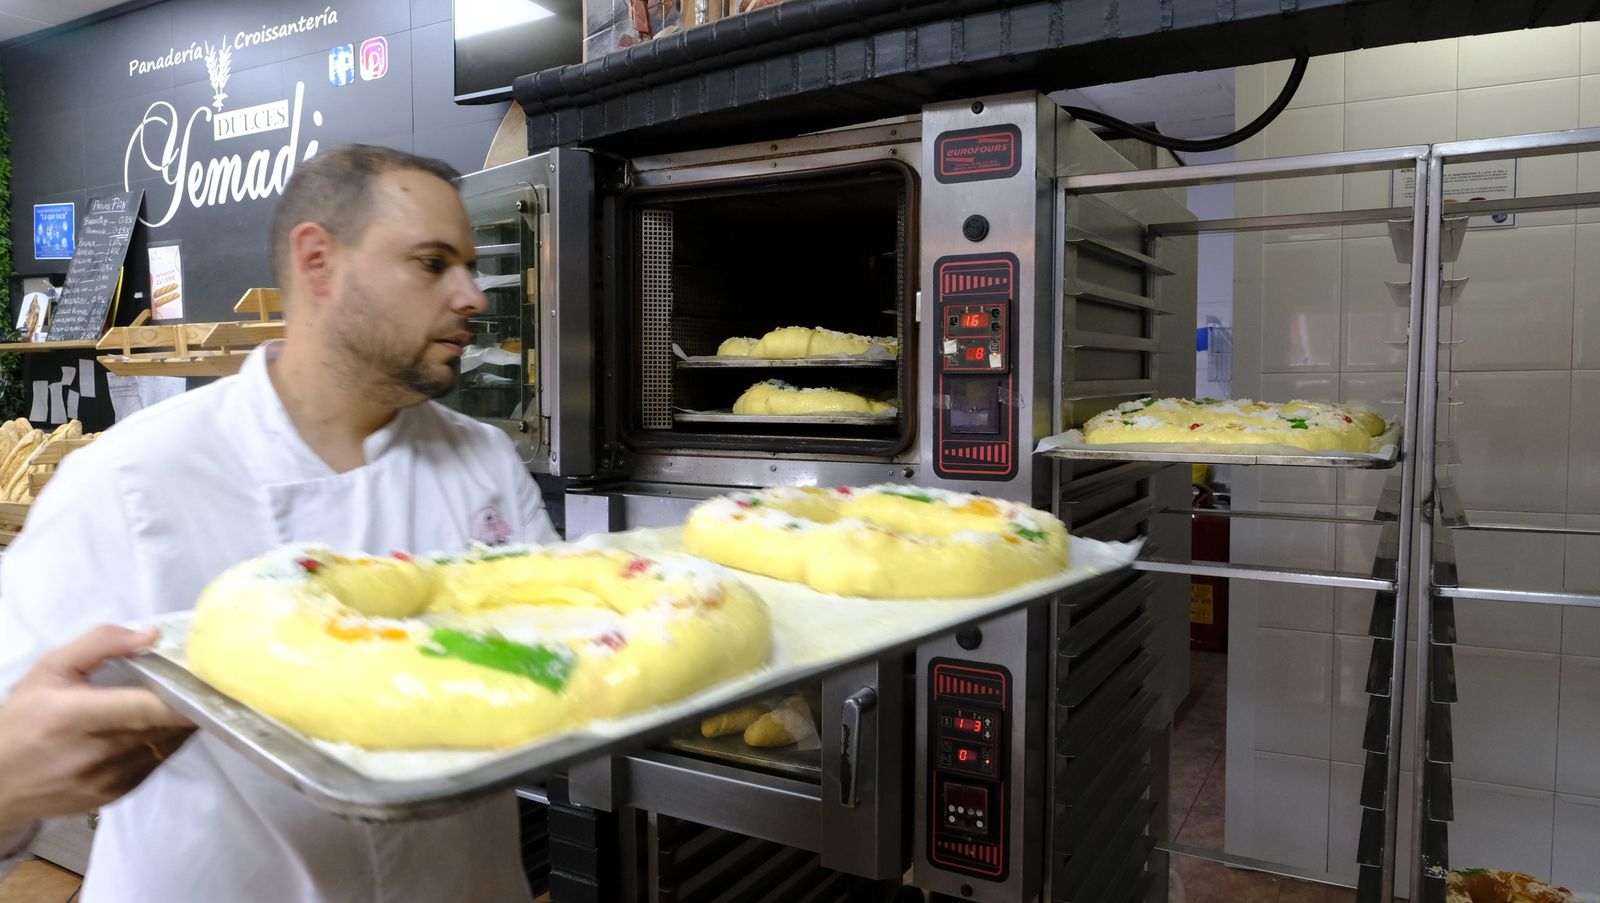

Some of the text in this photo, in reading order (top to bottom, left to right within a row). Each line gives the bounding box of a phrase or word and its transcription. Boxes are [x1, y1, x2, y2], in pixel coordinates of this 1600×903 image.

[234, 6, 338, 51] Croissantería
[129, 41, 204, 77] Panadería
[217, 106, 287, 137] DULCES
[975, 347, 984, 360] 8
[959, 750, 967, 761] 0
